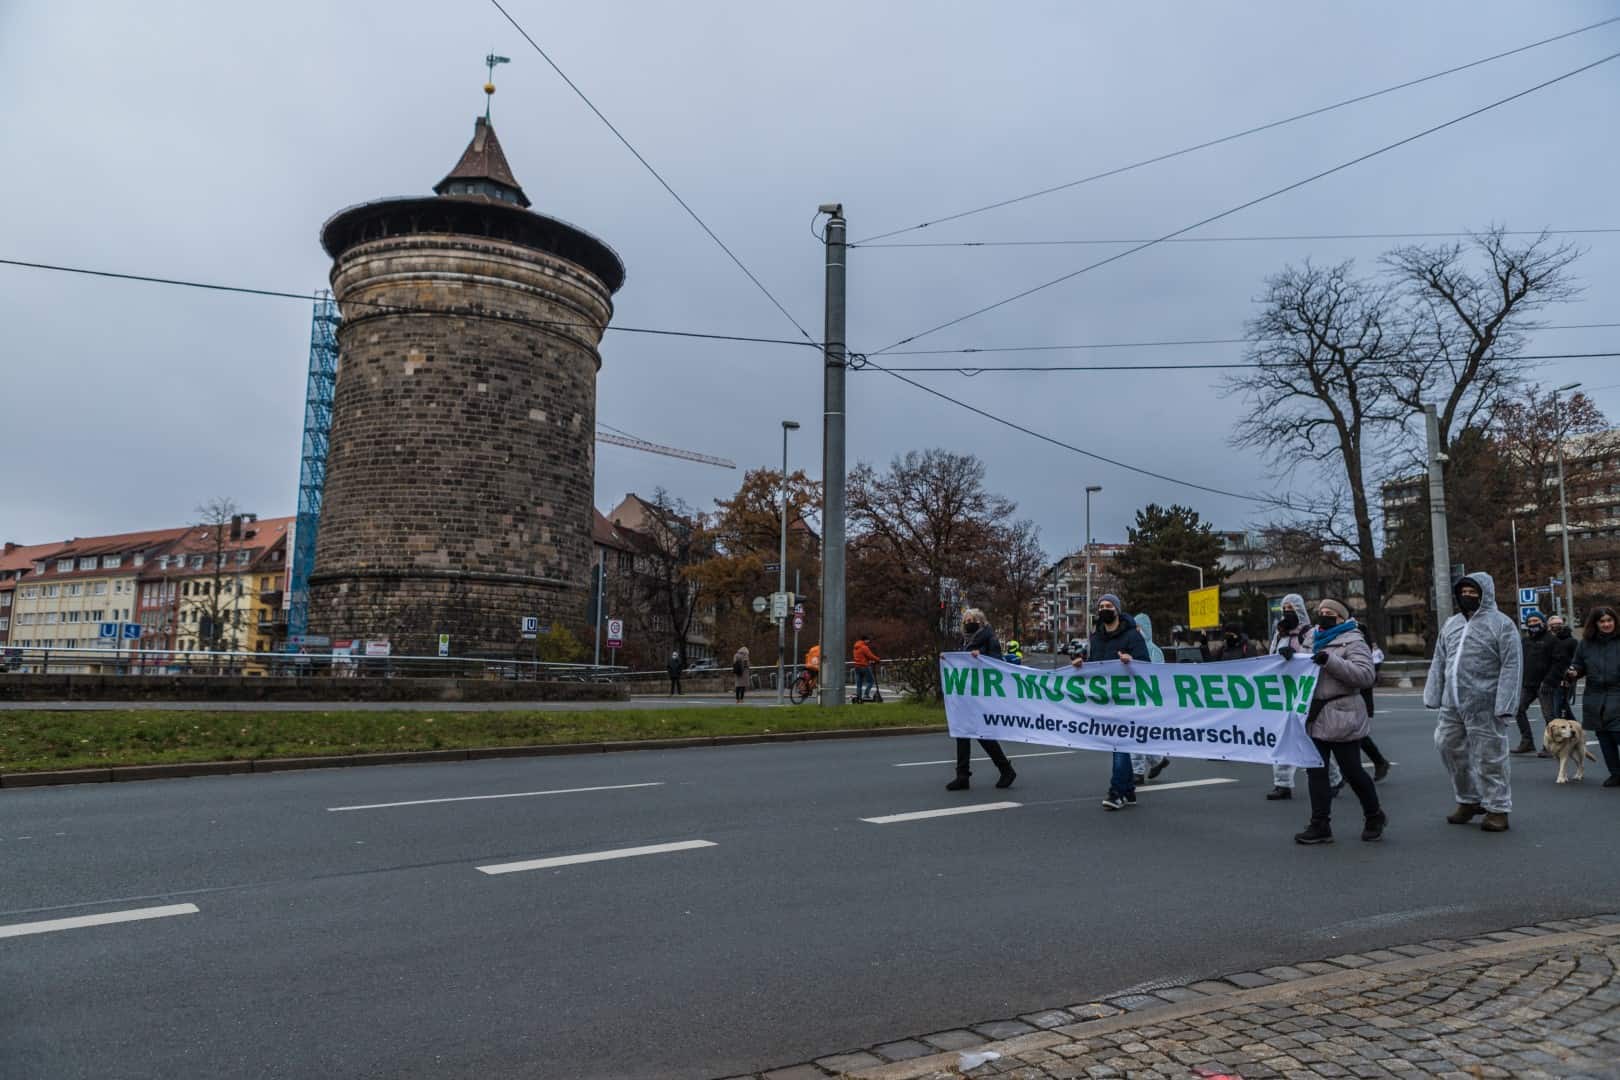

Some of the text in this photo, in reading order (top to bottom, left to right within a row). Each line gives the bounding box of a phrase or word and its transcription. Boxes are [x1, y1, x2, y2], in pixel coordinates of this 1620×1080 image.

[1522, 590, 1533, 601] U
[103, 624, 115, 636] U
[943, 667, 1006, 698] WIR
[1173, 674, 1316, 714] REDEN!
[983, 712, 1277, 749] www.der-schweigemarsch.de
